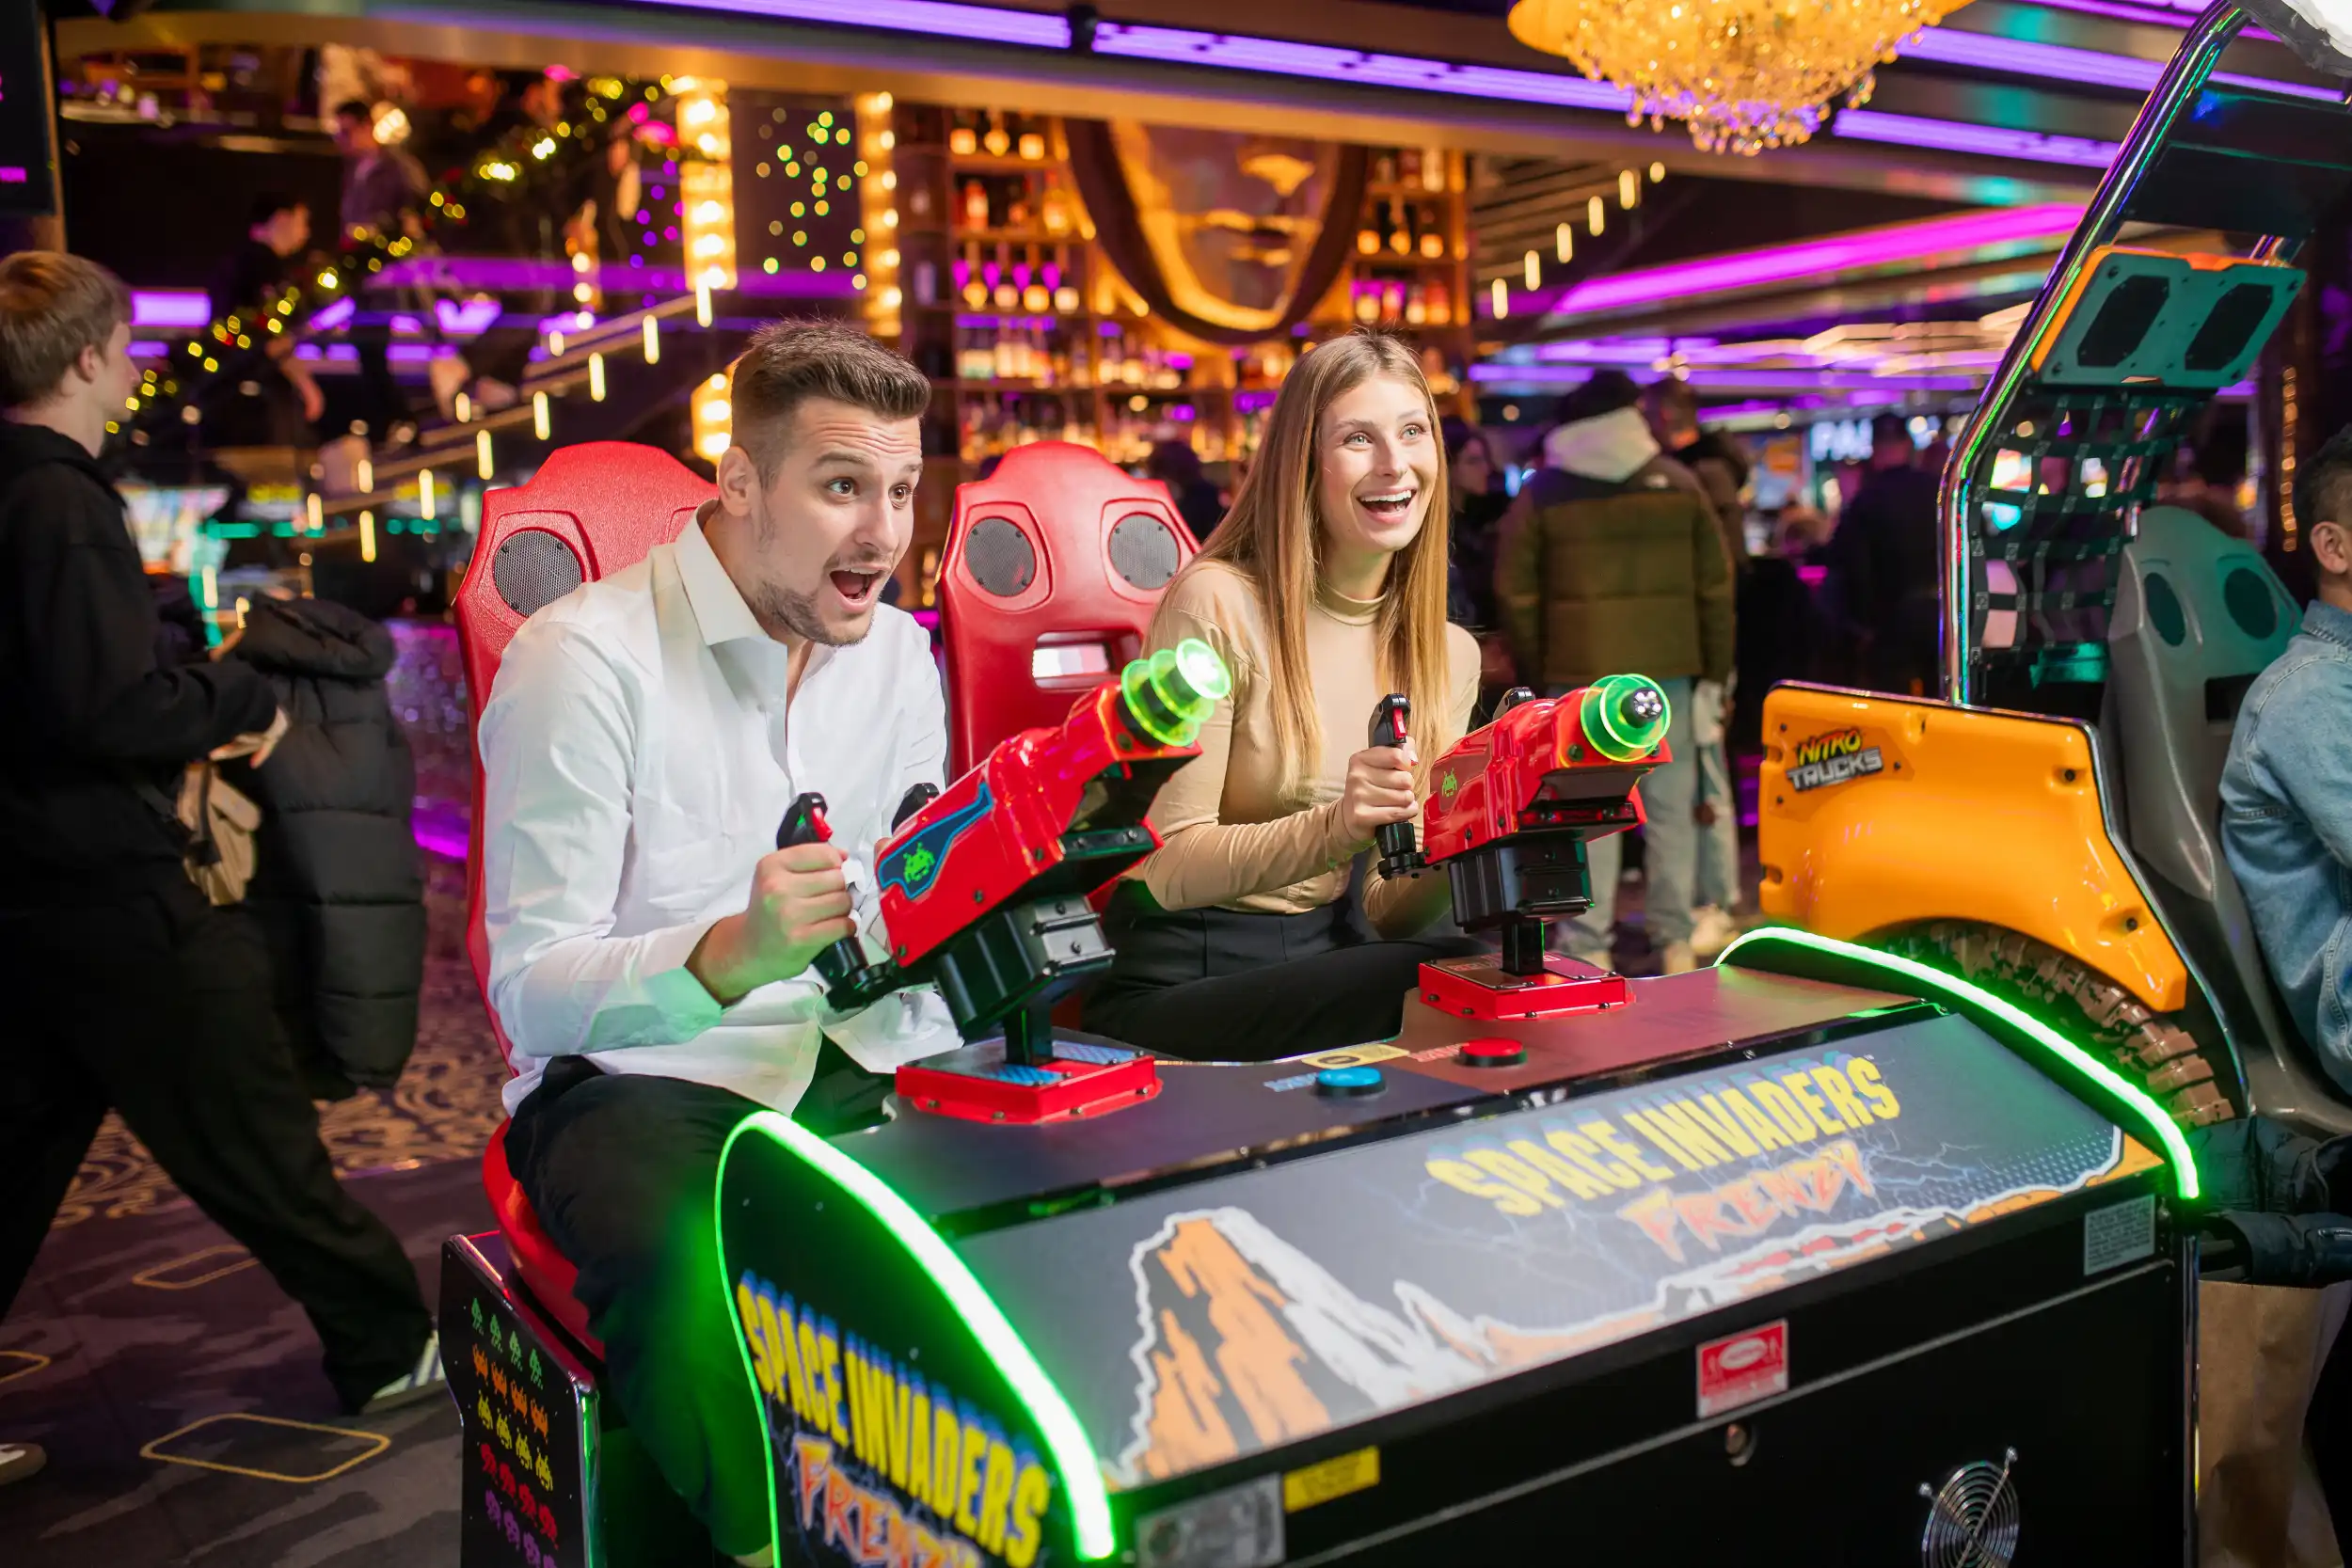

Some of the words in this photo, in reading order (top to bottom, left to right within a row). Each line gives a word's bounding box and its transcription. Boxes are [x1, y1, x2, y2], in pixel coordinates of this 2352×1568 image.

[1787, 746, 1883, 791] TRUCKS
[1798, 728, 1862, 767] NITRO
[1425, 1117, 1674, 1216] SPACE
[1623, 1055, 1900, 1171] INVADERS
[1616, 1138, 1875, 1263] FRENZY
[737, 1279, 849, 1449] SPACE
[844, 1345, 1050, 1567] INVADERS
